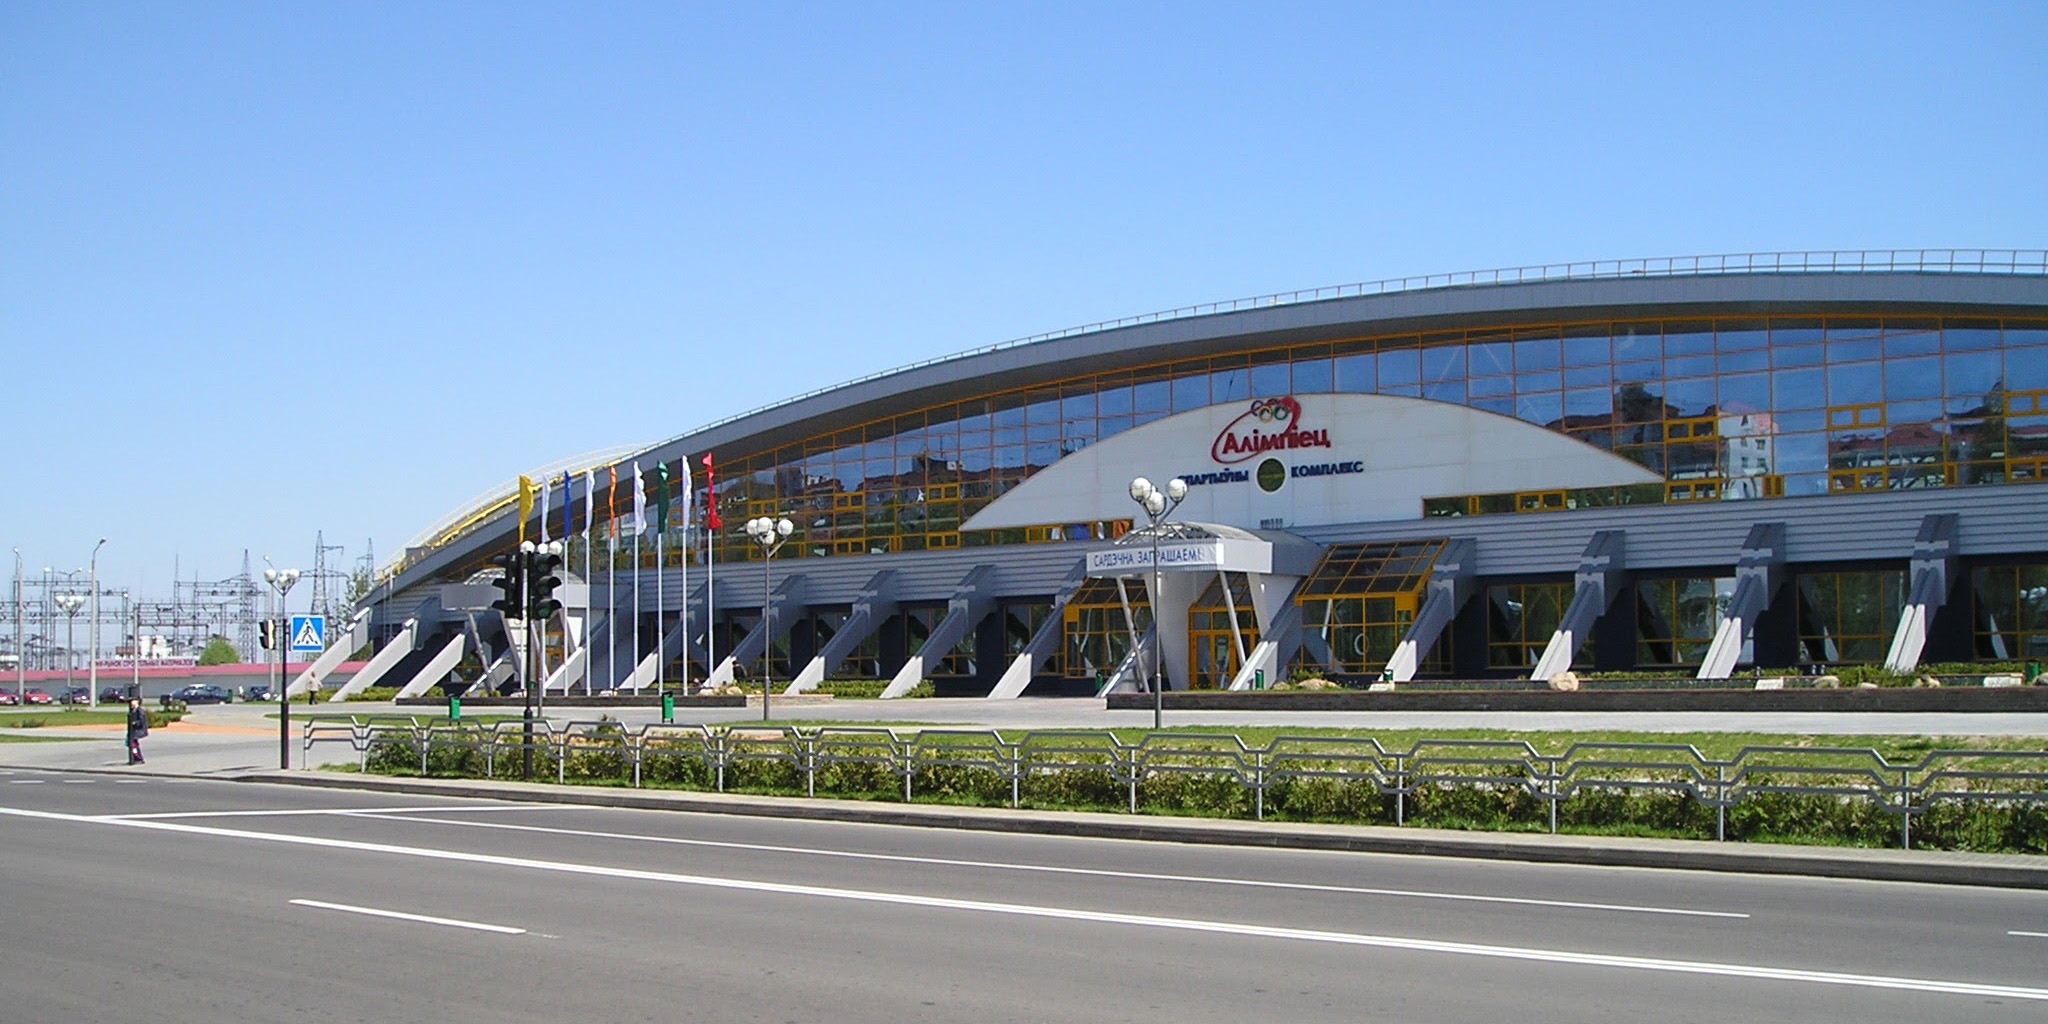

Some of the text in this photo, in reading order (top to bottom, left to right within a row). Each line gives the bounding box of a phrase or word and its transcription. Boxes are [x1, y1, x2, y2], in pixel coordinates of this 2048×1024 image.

[1222, 425, 1331, 454] Алімпіец
[1291, 461, 1364, 478] КОМПЛЕКС
[1094, 553, 1134, 567] САРДЭЧНА
